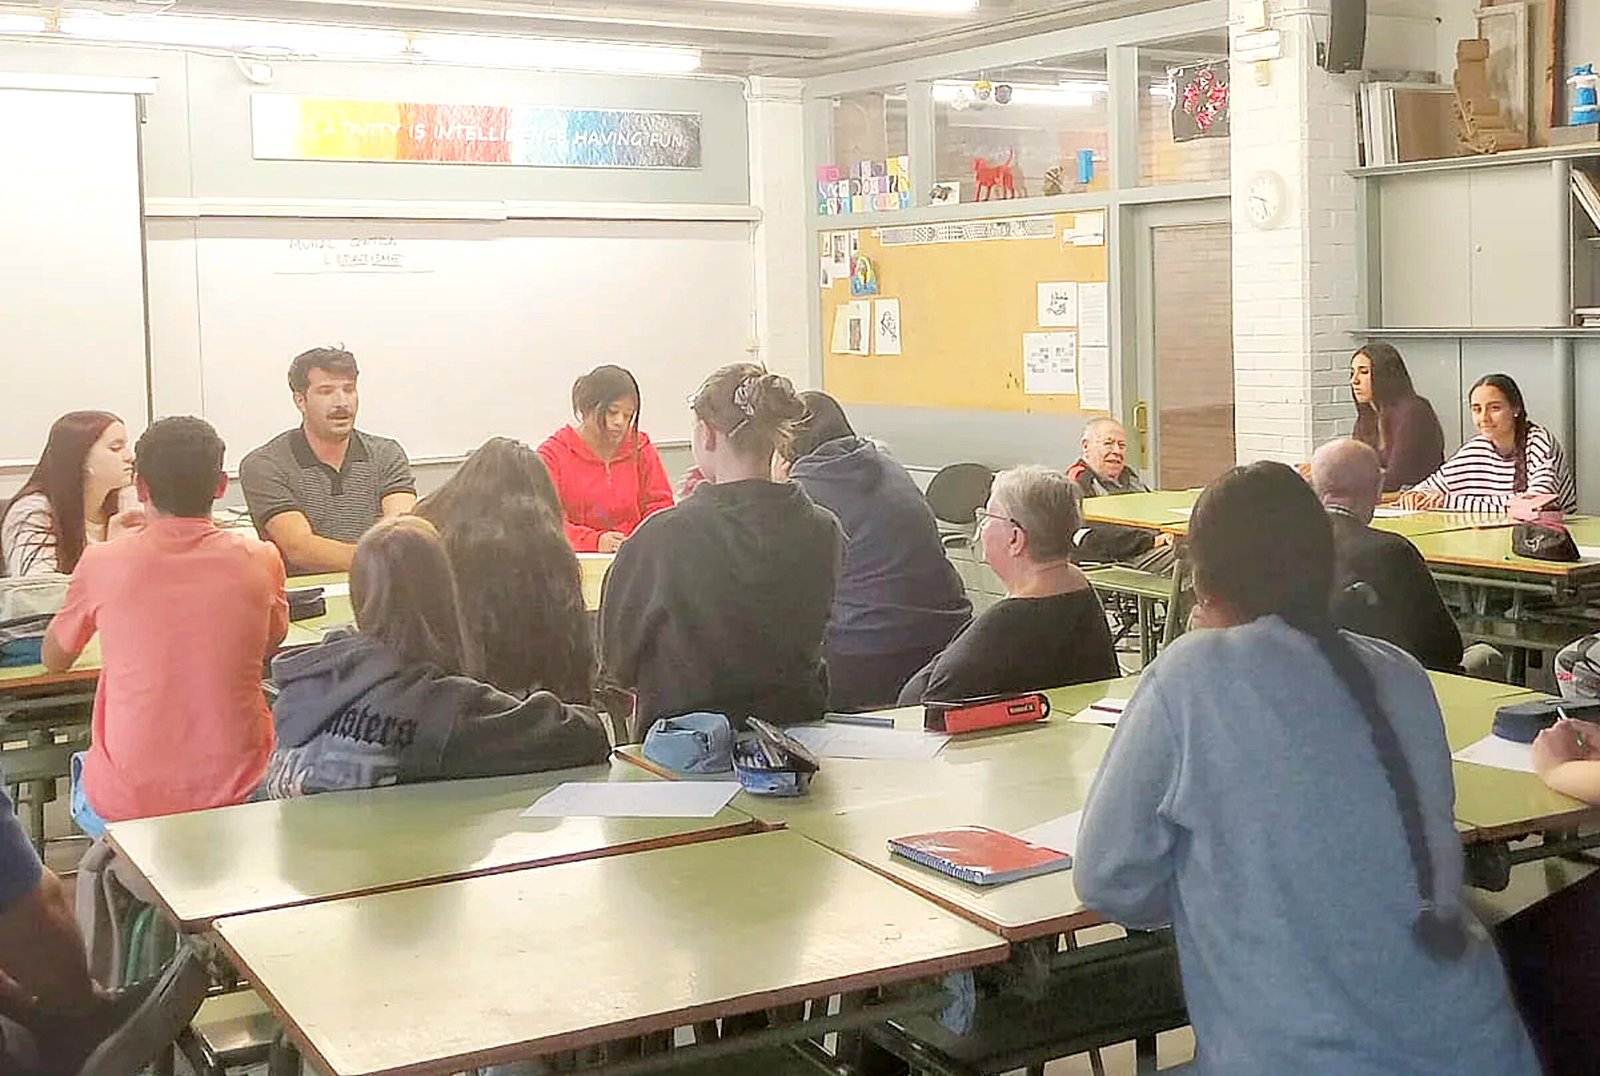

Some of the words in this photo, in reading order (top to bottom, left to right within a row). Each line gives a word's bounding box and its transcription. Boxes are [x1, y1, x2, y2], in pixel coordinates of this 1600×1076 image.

[408, 123, 427, 141] IS
[434, 124, 567, 143] INTELLIENCE
[574, 130, 643, 147] HAVING
[649, 132, 685, 149] FUN
